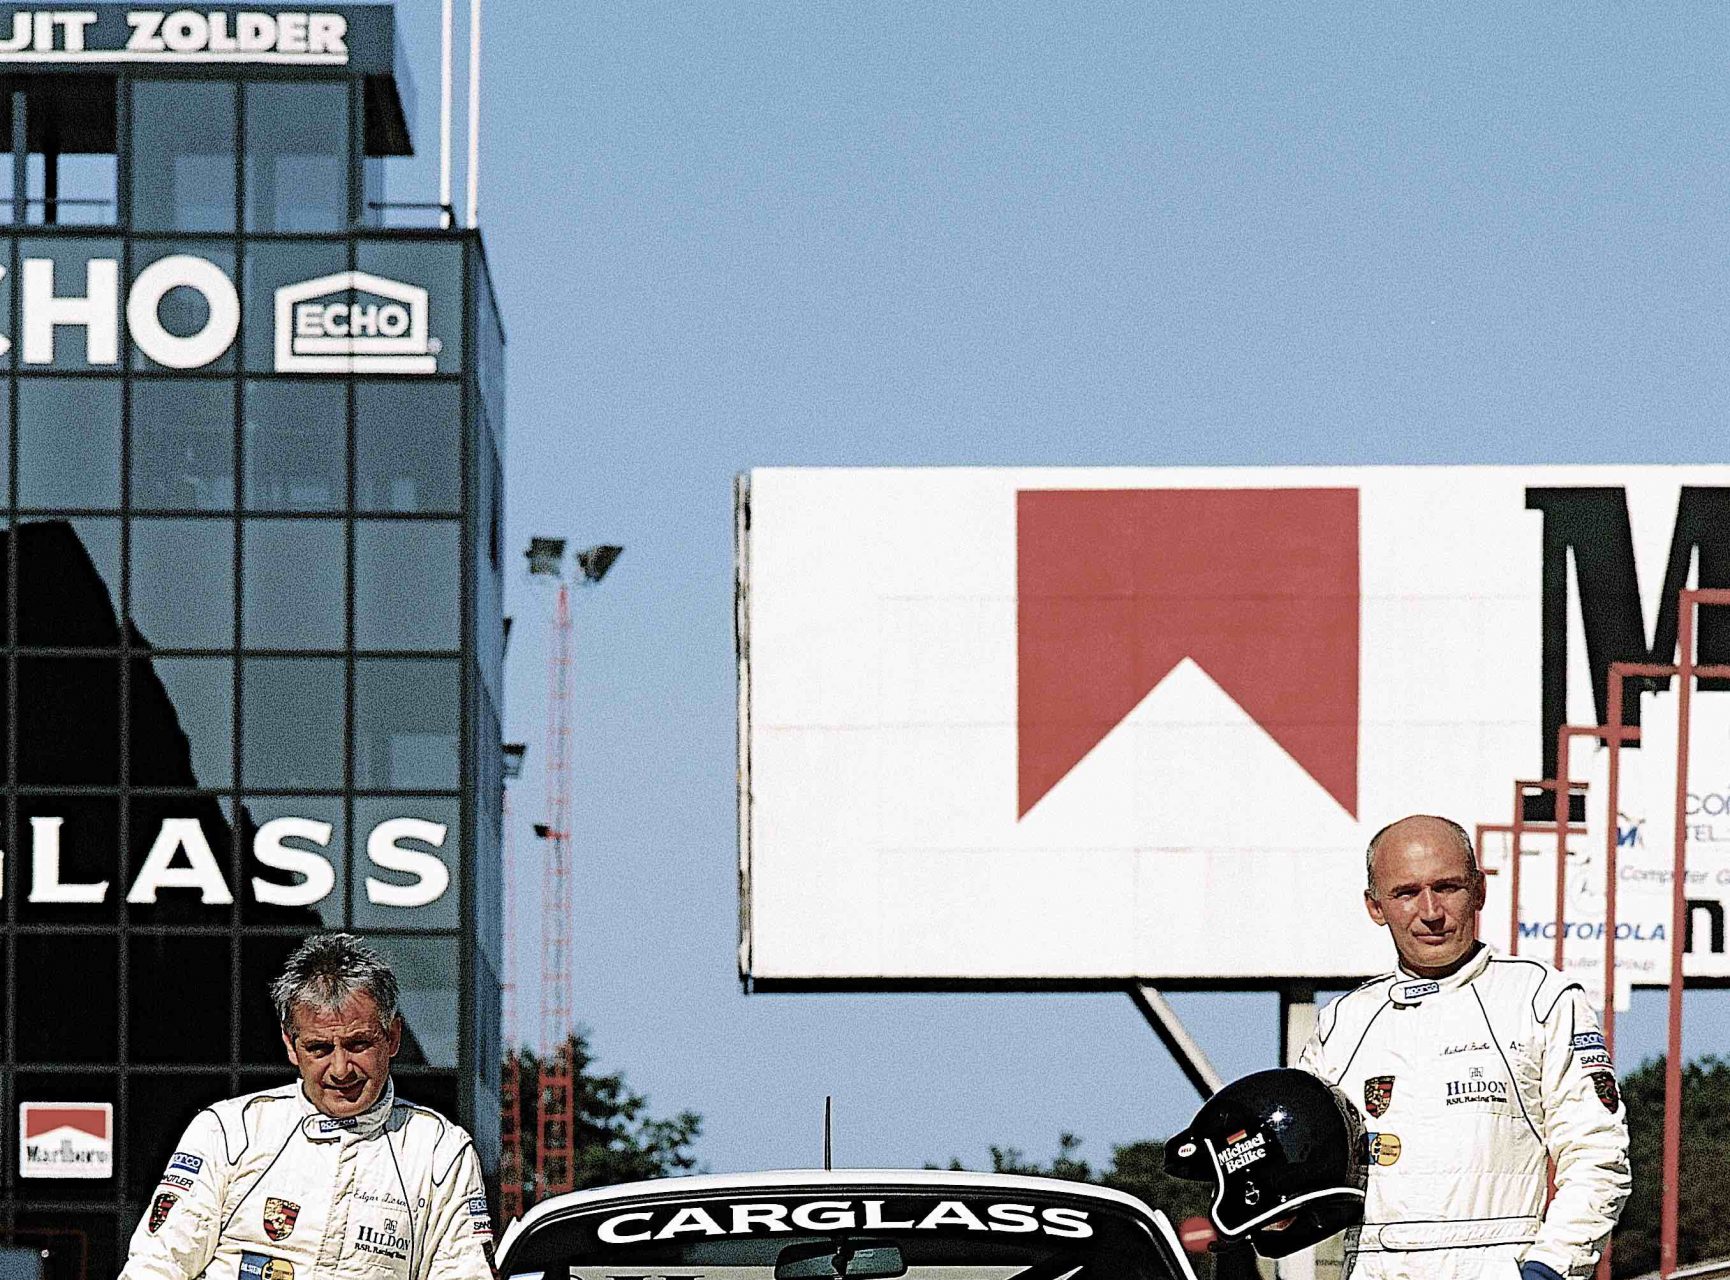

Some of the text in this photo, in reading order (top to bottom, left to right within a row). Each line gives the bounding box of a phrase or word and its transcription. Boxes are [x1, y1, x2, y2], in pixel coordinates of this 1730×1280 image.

[125, 11, 348, 53] ZOLDER
[0, 255, 240, 369] HO
[298, 303, 410, 337] ECHO
[0, 817, 450, 906] LASS
[1446, 1081, 1507, 1096] HILDON
[357, 1225, 411, 1251] HILDON
[597, 1201, 1094, 1243] CARGLASS
